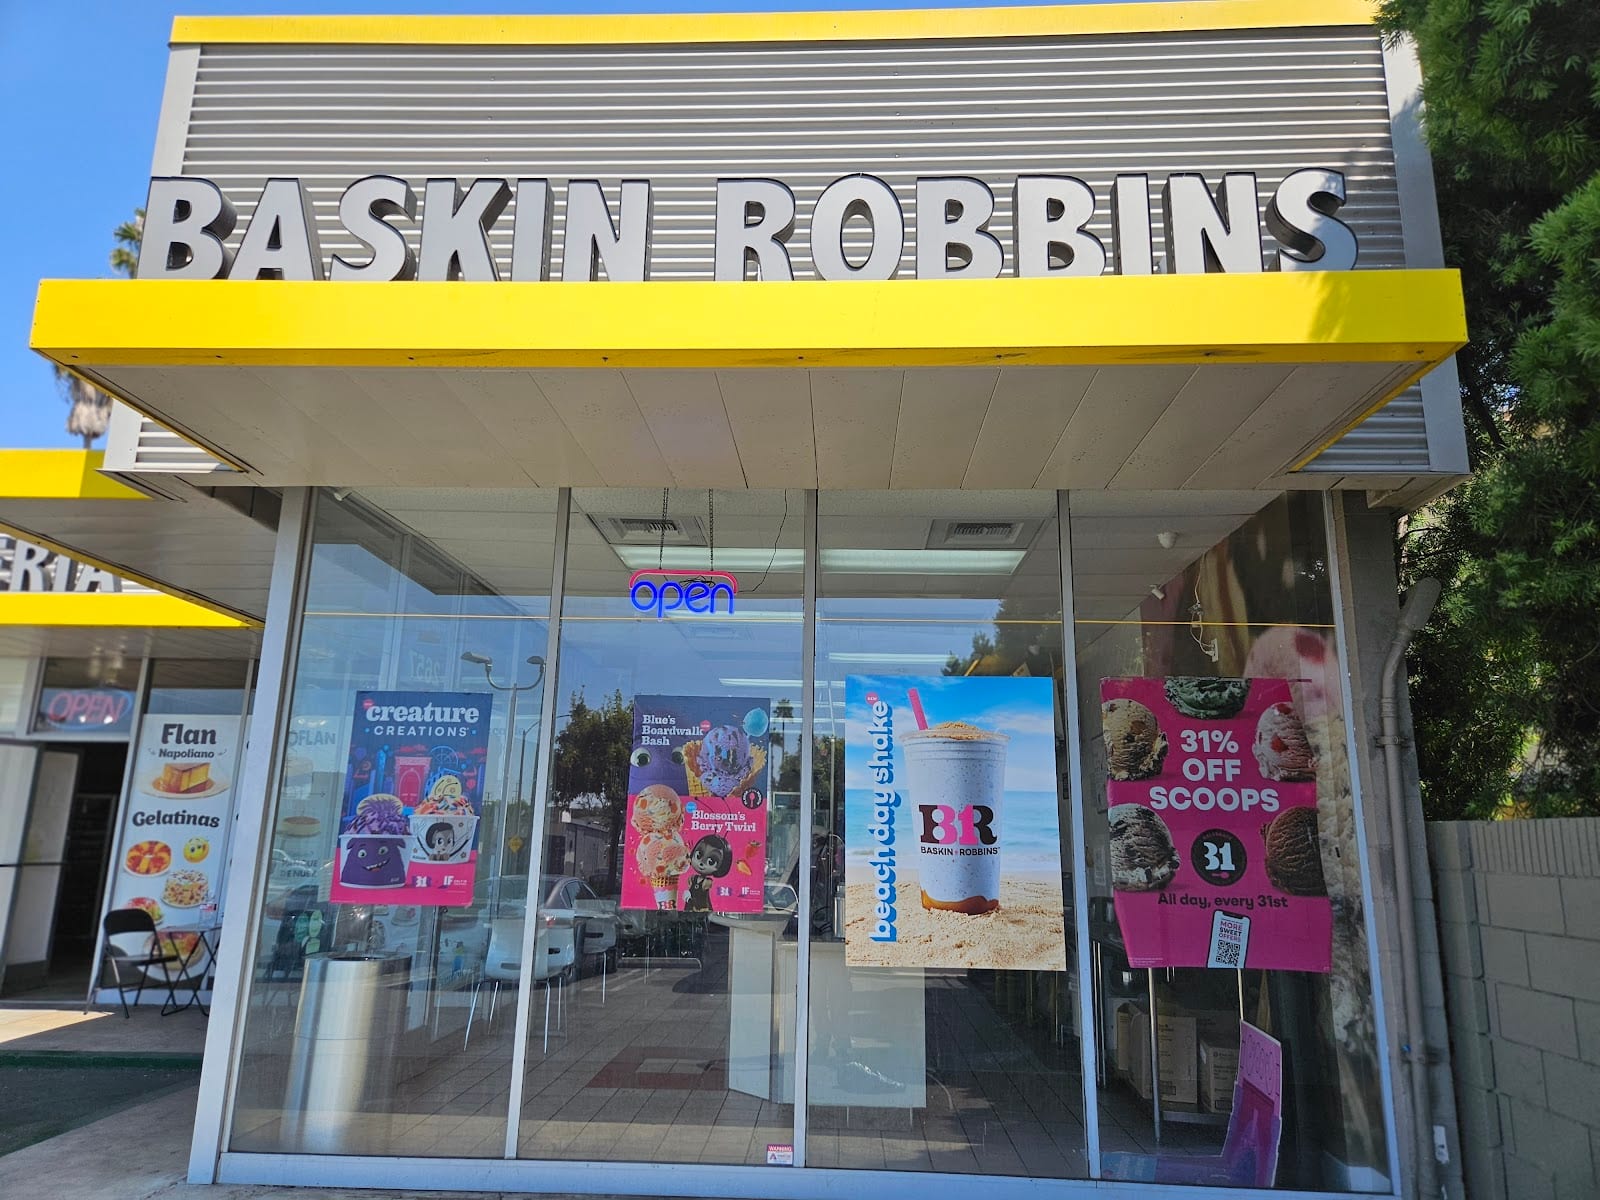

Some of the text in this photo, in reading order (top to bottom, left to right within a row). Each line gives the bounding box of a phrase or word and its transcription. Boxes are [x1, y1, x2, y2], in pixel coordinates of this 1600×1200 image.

[136, 168, 1360, 281] BASKIN ROBBINS
[631, 580, 735, 621] open
[48, 691, 126, 722] OPEN
[366, 702, 480, 723] creature
[642, 714, 676, 725] Blue's
[161, 723, 217, 745] Flan
[374, 725, 469, 737] CREATIONS
[641, 724, 704, 736] Boardwalk
[641, 735, 670, 746] Bash
[1180, 729, 1239, 754] 31%
[158, 748, 215, 760] Napoliano
[1182, 757, 1241, 782] OFF
[1149, 786, 1280, 812] SCOOPS
[132, 809, 220, 828] Gelatinas
[691, 810, 746, 821] Blossom's
[867, 700, 901, 943] beach day shake
[691, 820, 757, 833] Berry Twirl
[920, 846, 998, 857] BASKIN ROBBINS
[1203, 841, 1236, 871] 31
[1158, 893, 1289, 910] All day, every 31st
[1219, 927, 1242, 937] SWEET
[1220, 920, 1243, 931] MORE
